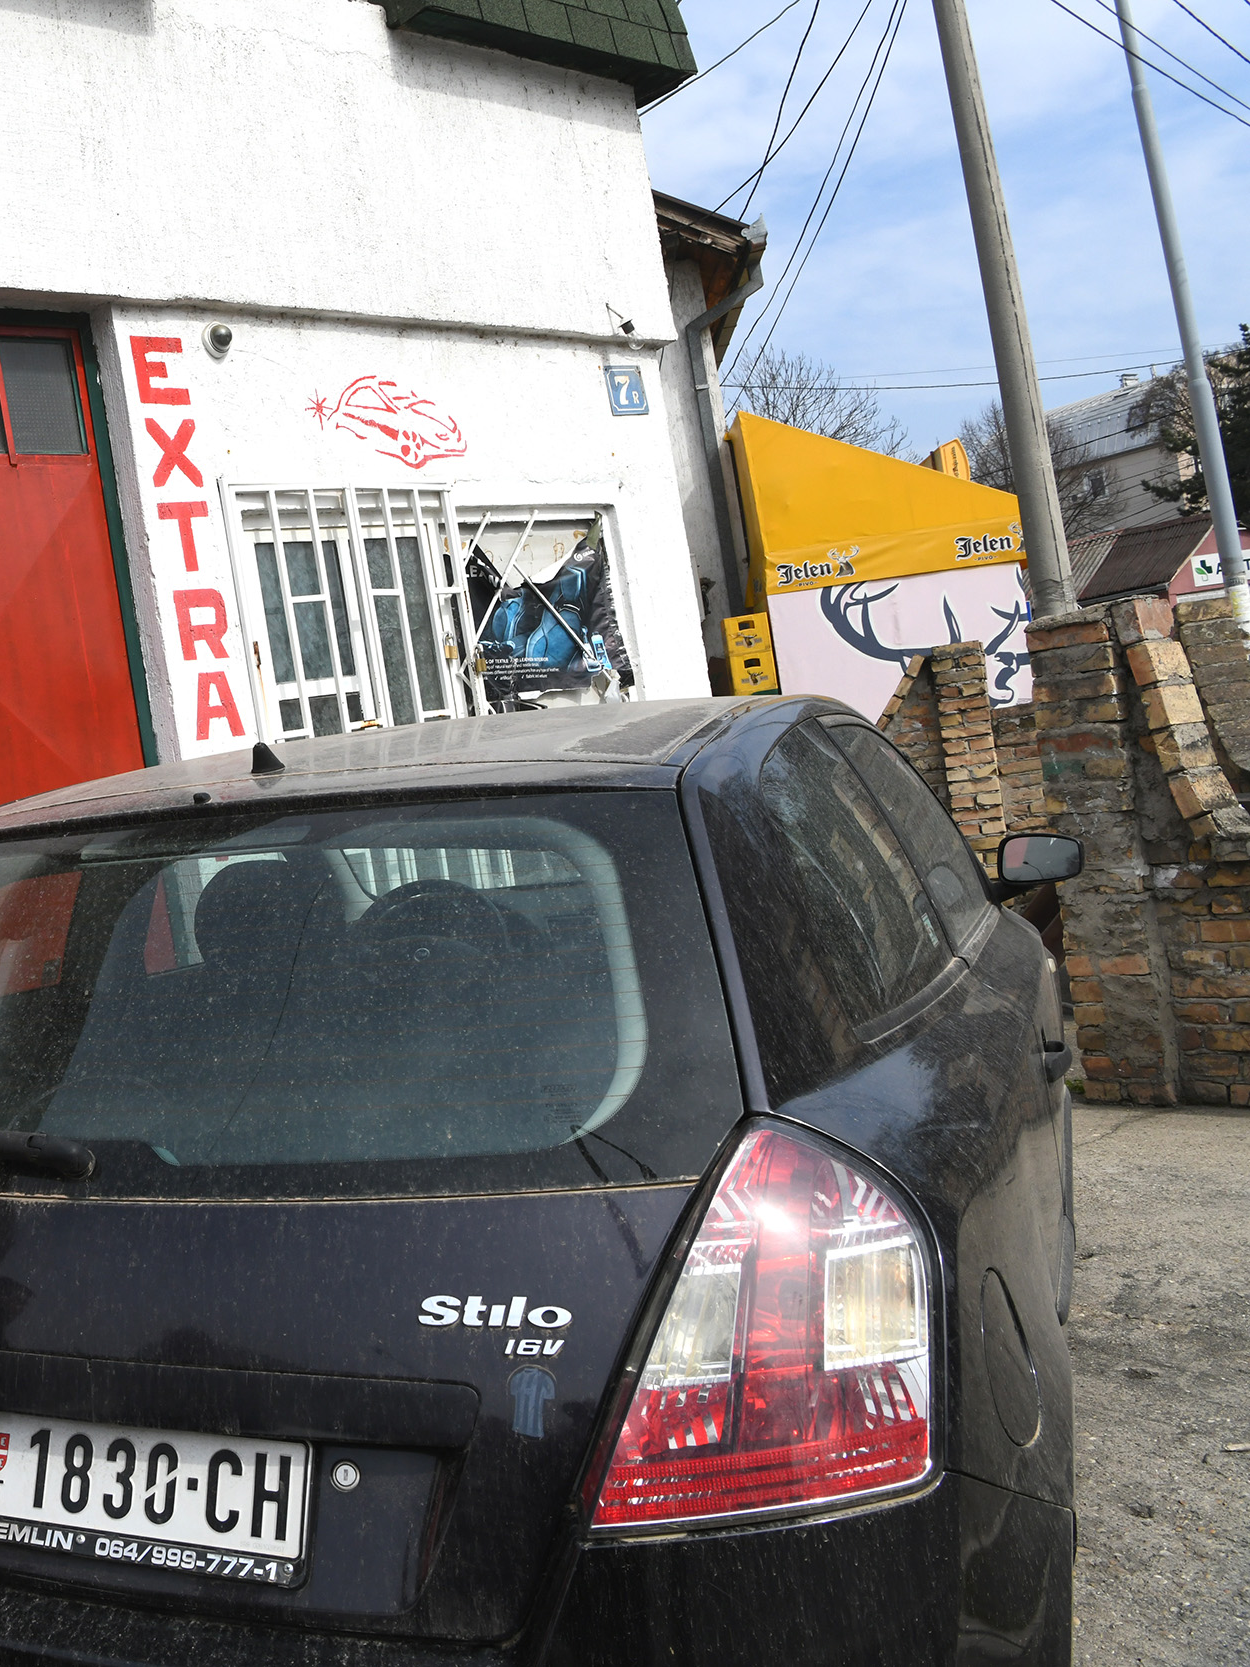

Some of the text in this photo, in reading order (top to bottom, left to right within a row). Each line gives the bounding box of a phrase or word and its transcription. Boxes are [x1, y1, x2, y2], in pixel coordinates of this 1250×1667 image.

[130, 335, 246, 740] EXTRA
[954, 534, 1014, 560] Jelen
[777, 560, 833, 587] Jelen
[417, 1295, 573, 1329] Stilo
[504, 1339, 565, 1356] 16V
